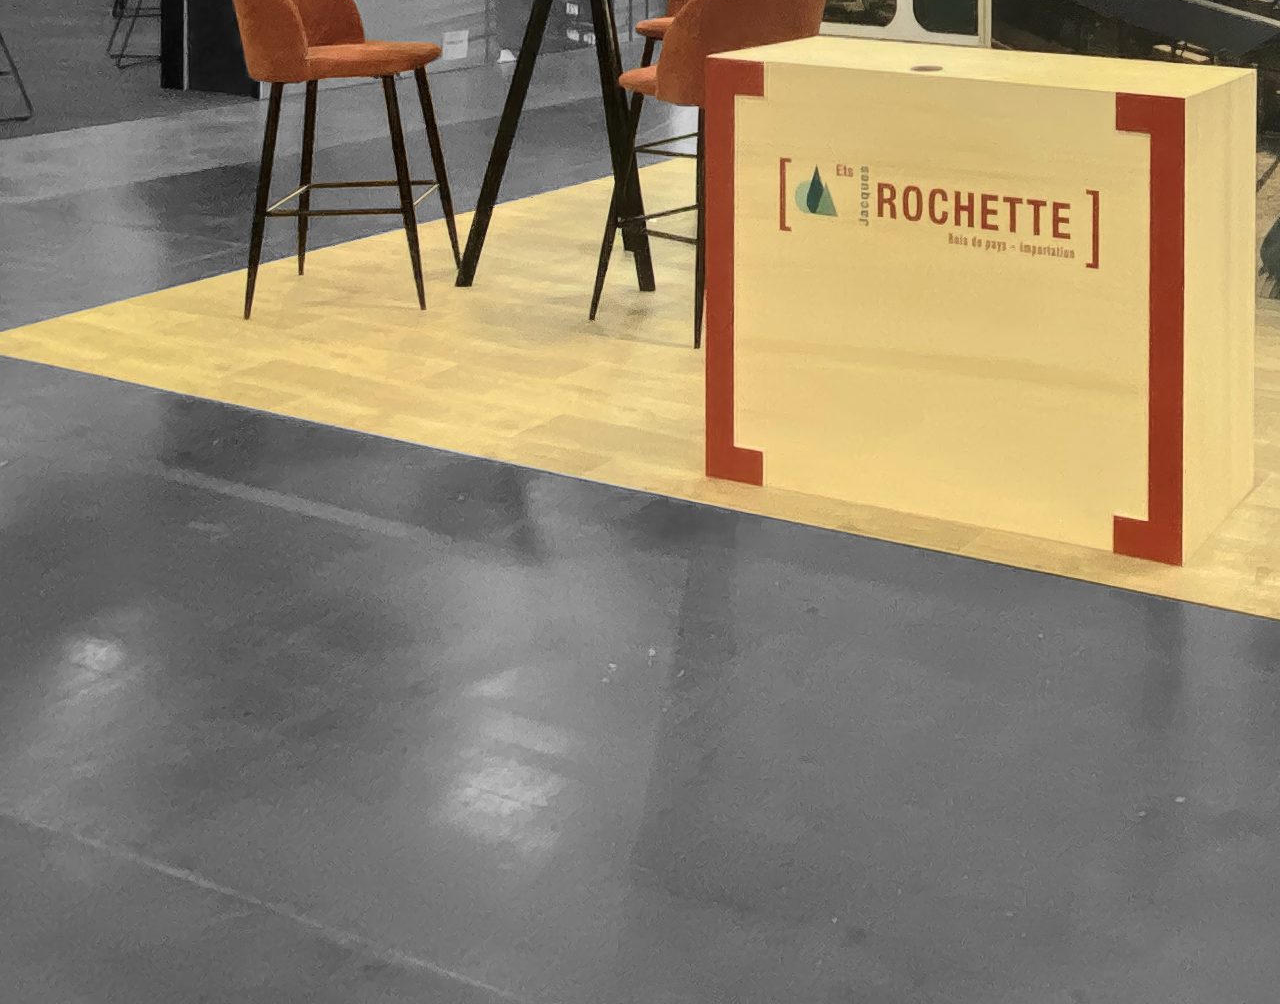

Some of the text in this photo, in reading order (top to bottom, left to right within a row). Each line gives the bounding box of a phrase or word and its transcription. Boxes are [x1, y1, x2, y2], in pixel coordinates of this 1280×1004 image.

[836, 164, 853, 177] Ets
[858, 166, 871, 226] Jacques
[877, 183, 1071, 240] ROCHETTE
[948, 233, 968, 246] Bois
[985, 240, 1006, 252] pays
